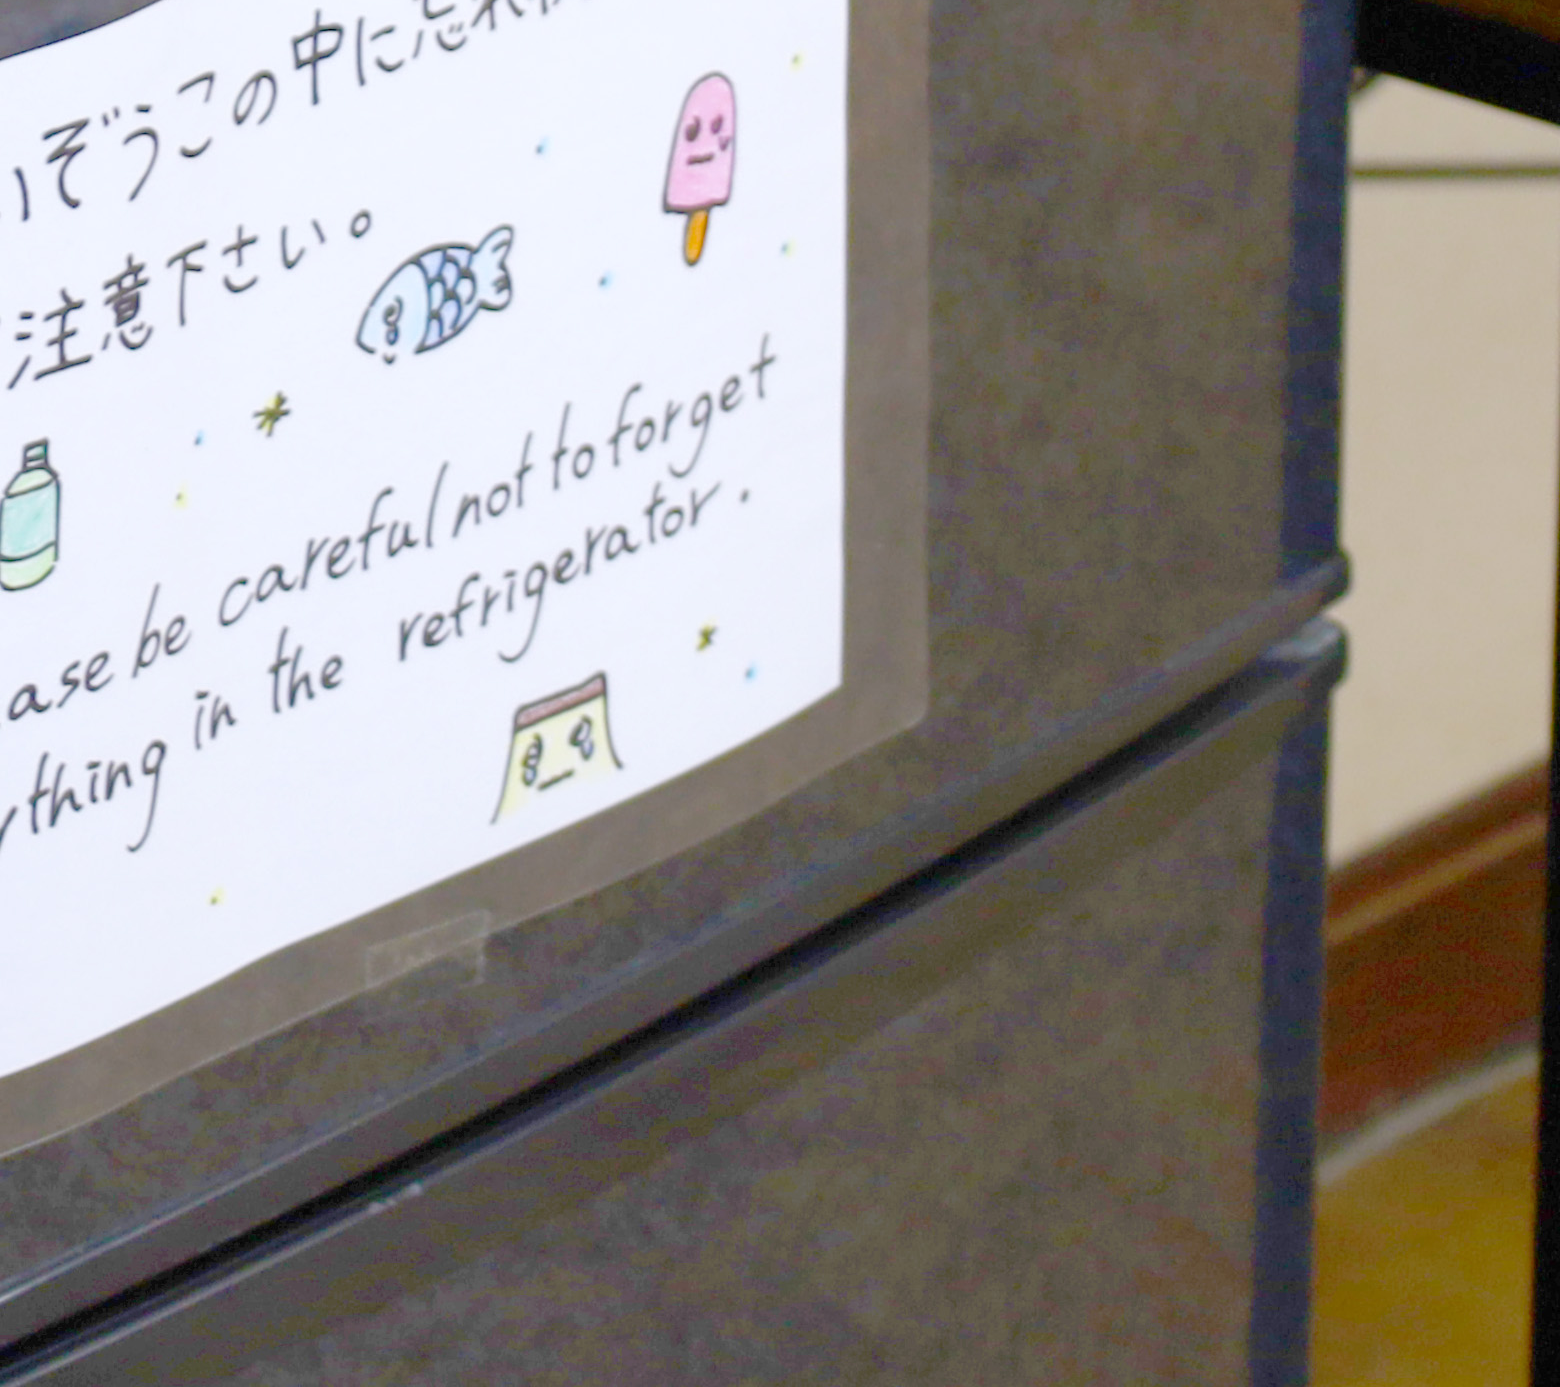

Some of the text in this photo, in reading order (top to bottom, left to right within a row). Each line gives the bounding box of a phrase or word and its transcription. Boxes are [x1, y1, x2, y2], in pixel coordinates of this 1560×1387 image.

[131, 583, 193, 679] be
[218, 460, 450, 628] careful
[451, 430, 535, 539] not
[551, 400, 596, 491] to
[606, 332, 777, 479] forget
[193, 689, 238, 751] in
[267, 625, 345, 715] the
[397, 480, 751, 663] refrigerator.
